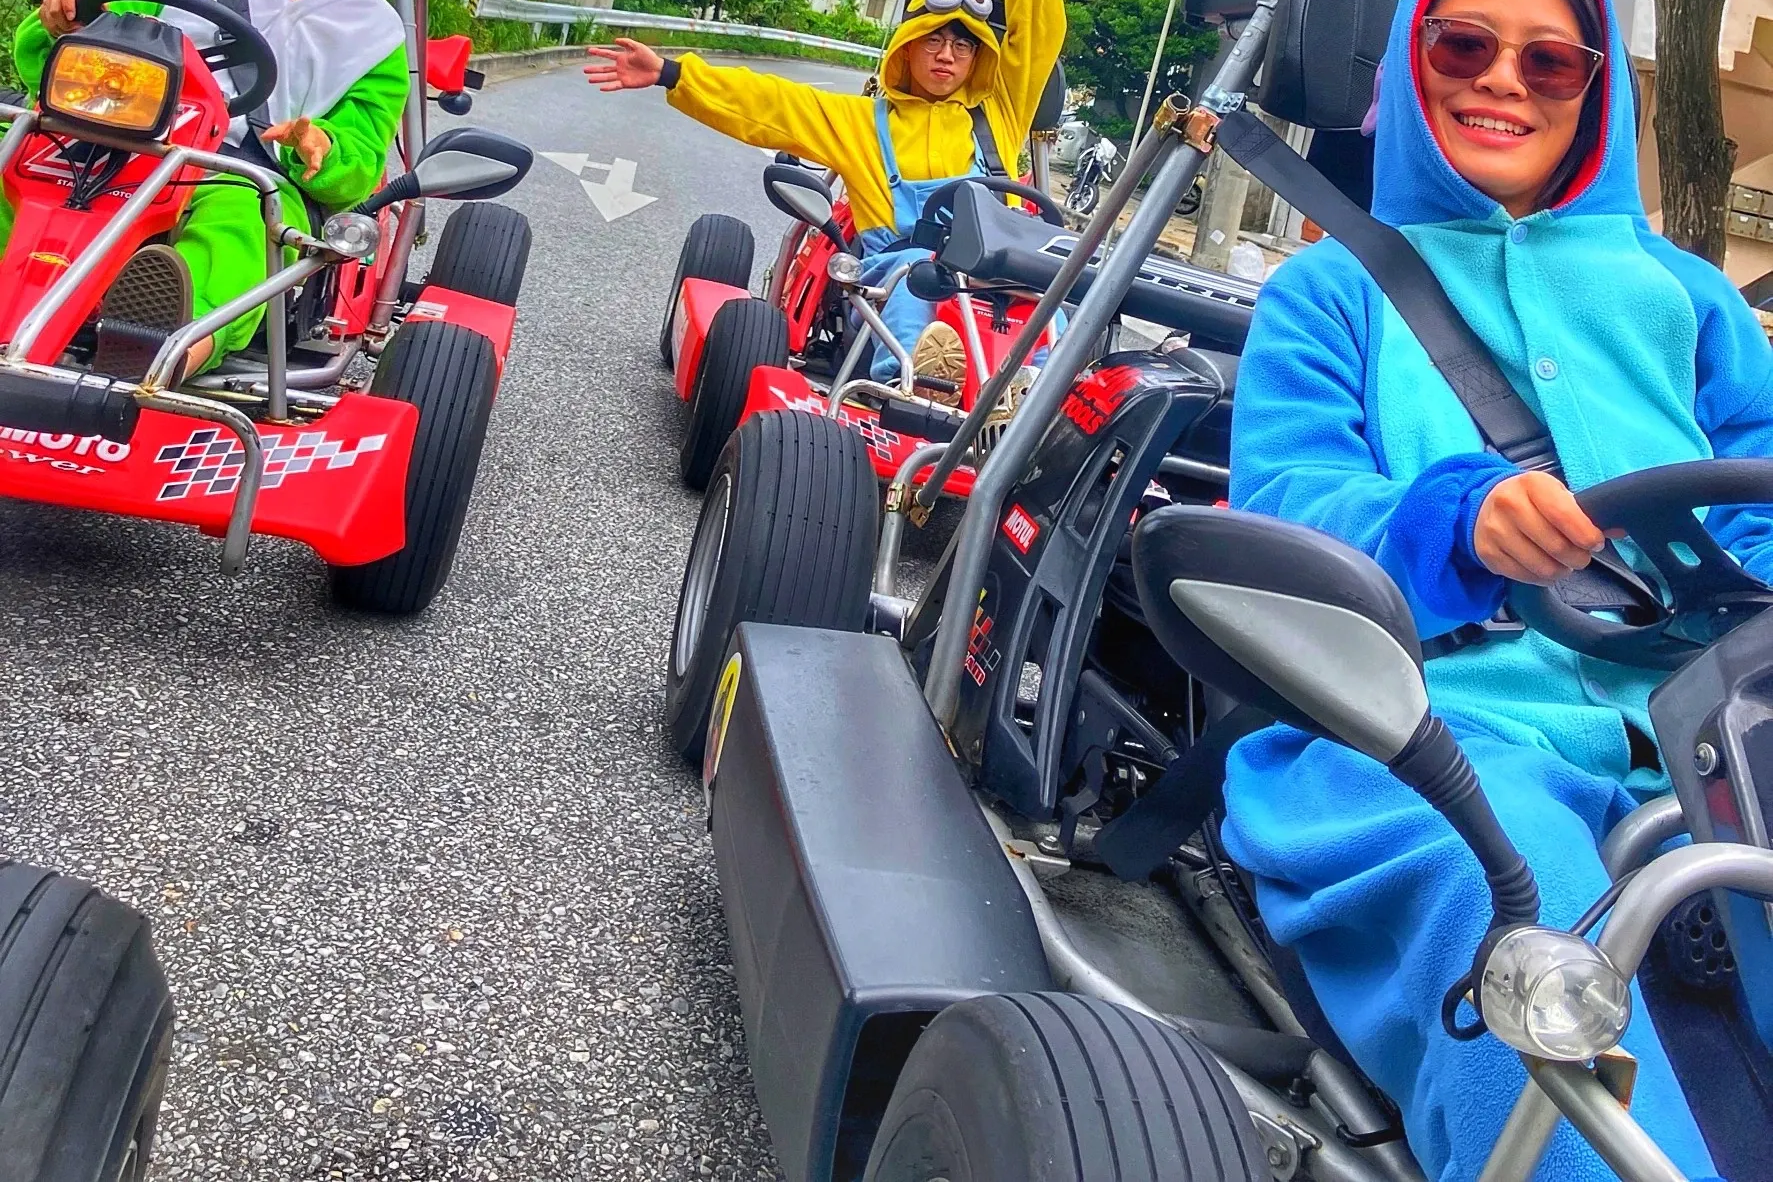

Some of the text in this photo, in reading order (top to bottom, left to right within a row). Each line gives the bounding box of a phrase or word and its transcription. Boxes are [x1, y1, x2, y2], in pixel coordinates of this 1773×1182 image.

[1060, 393, 1104, 435] TOOLS
[0, 448, 107, 475] wer
[1004, 508, 1036, 549] MOTUL
